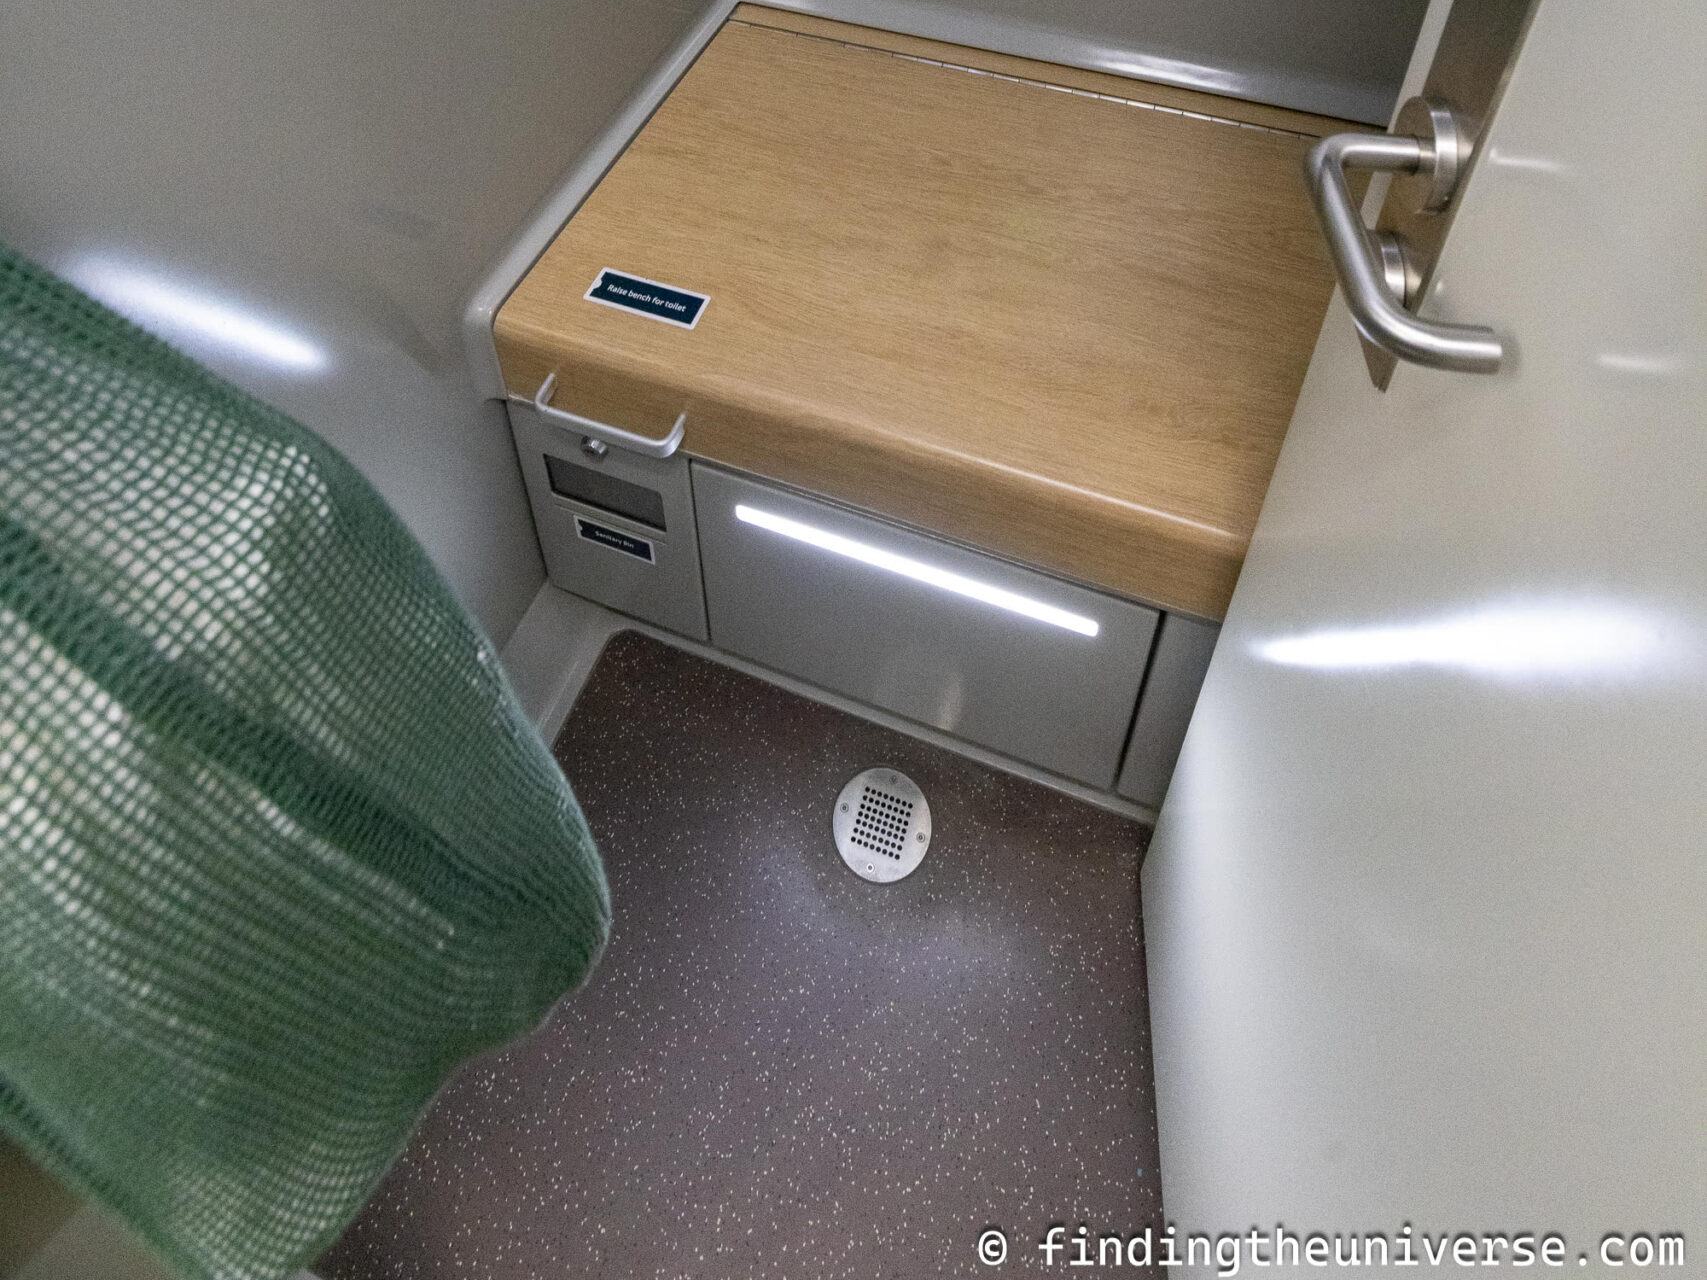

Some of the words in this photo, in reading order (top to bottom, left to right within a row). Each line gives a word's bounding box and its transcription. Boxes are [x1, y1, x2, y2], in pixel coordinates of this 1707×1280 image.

[607, 284, 627, 296] Raise
[628, 290, 650, 303] bench
[652, 296, 664, 306] for
[665, 300, 687, 312] toilet
